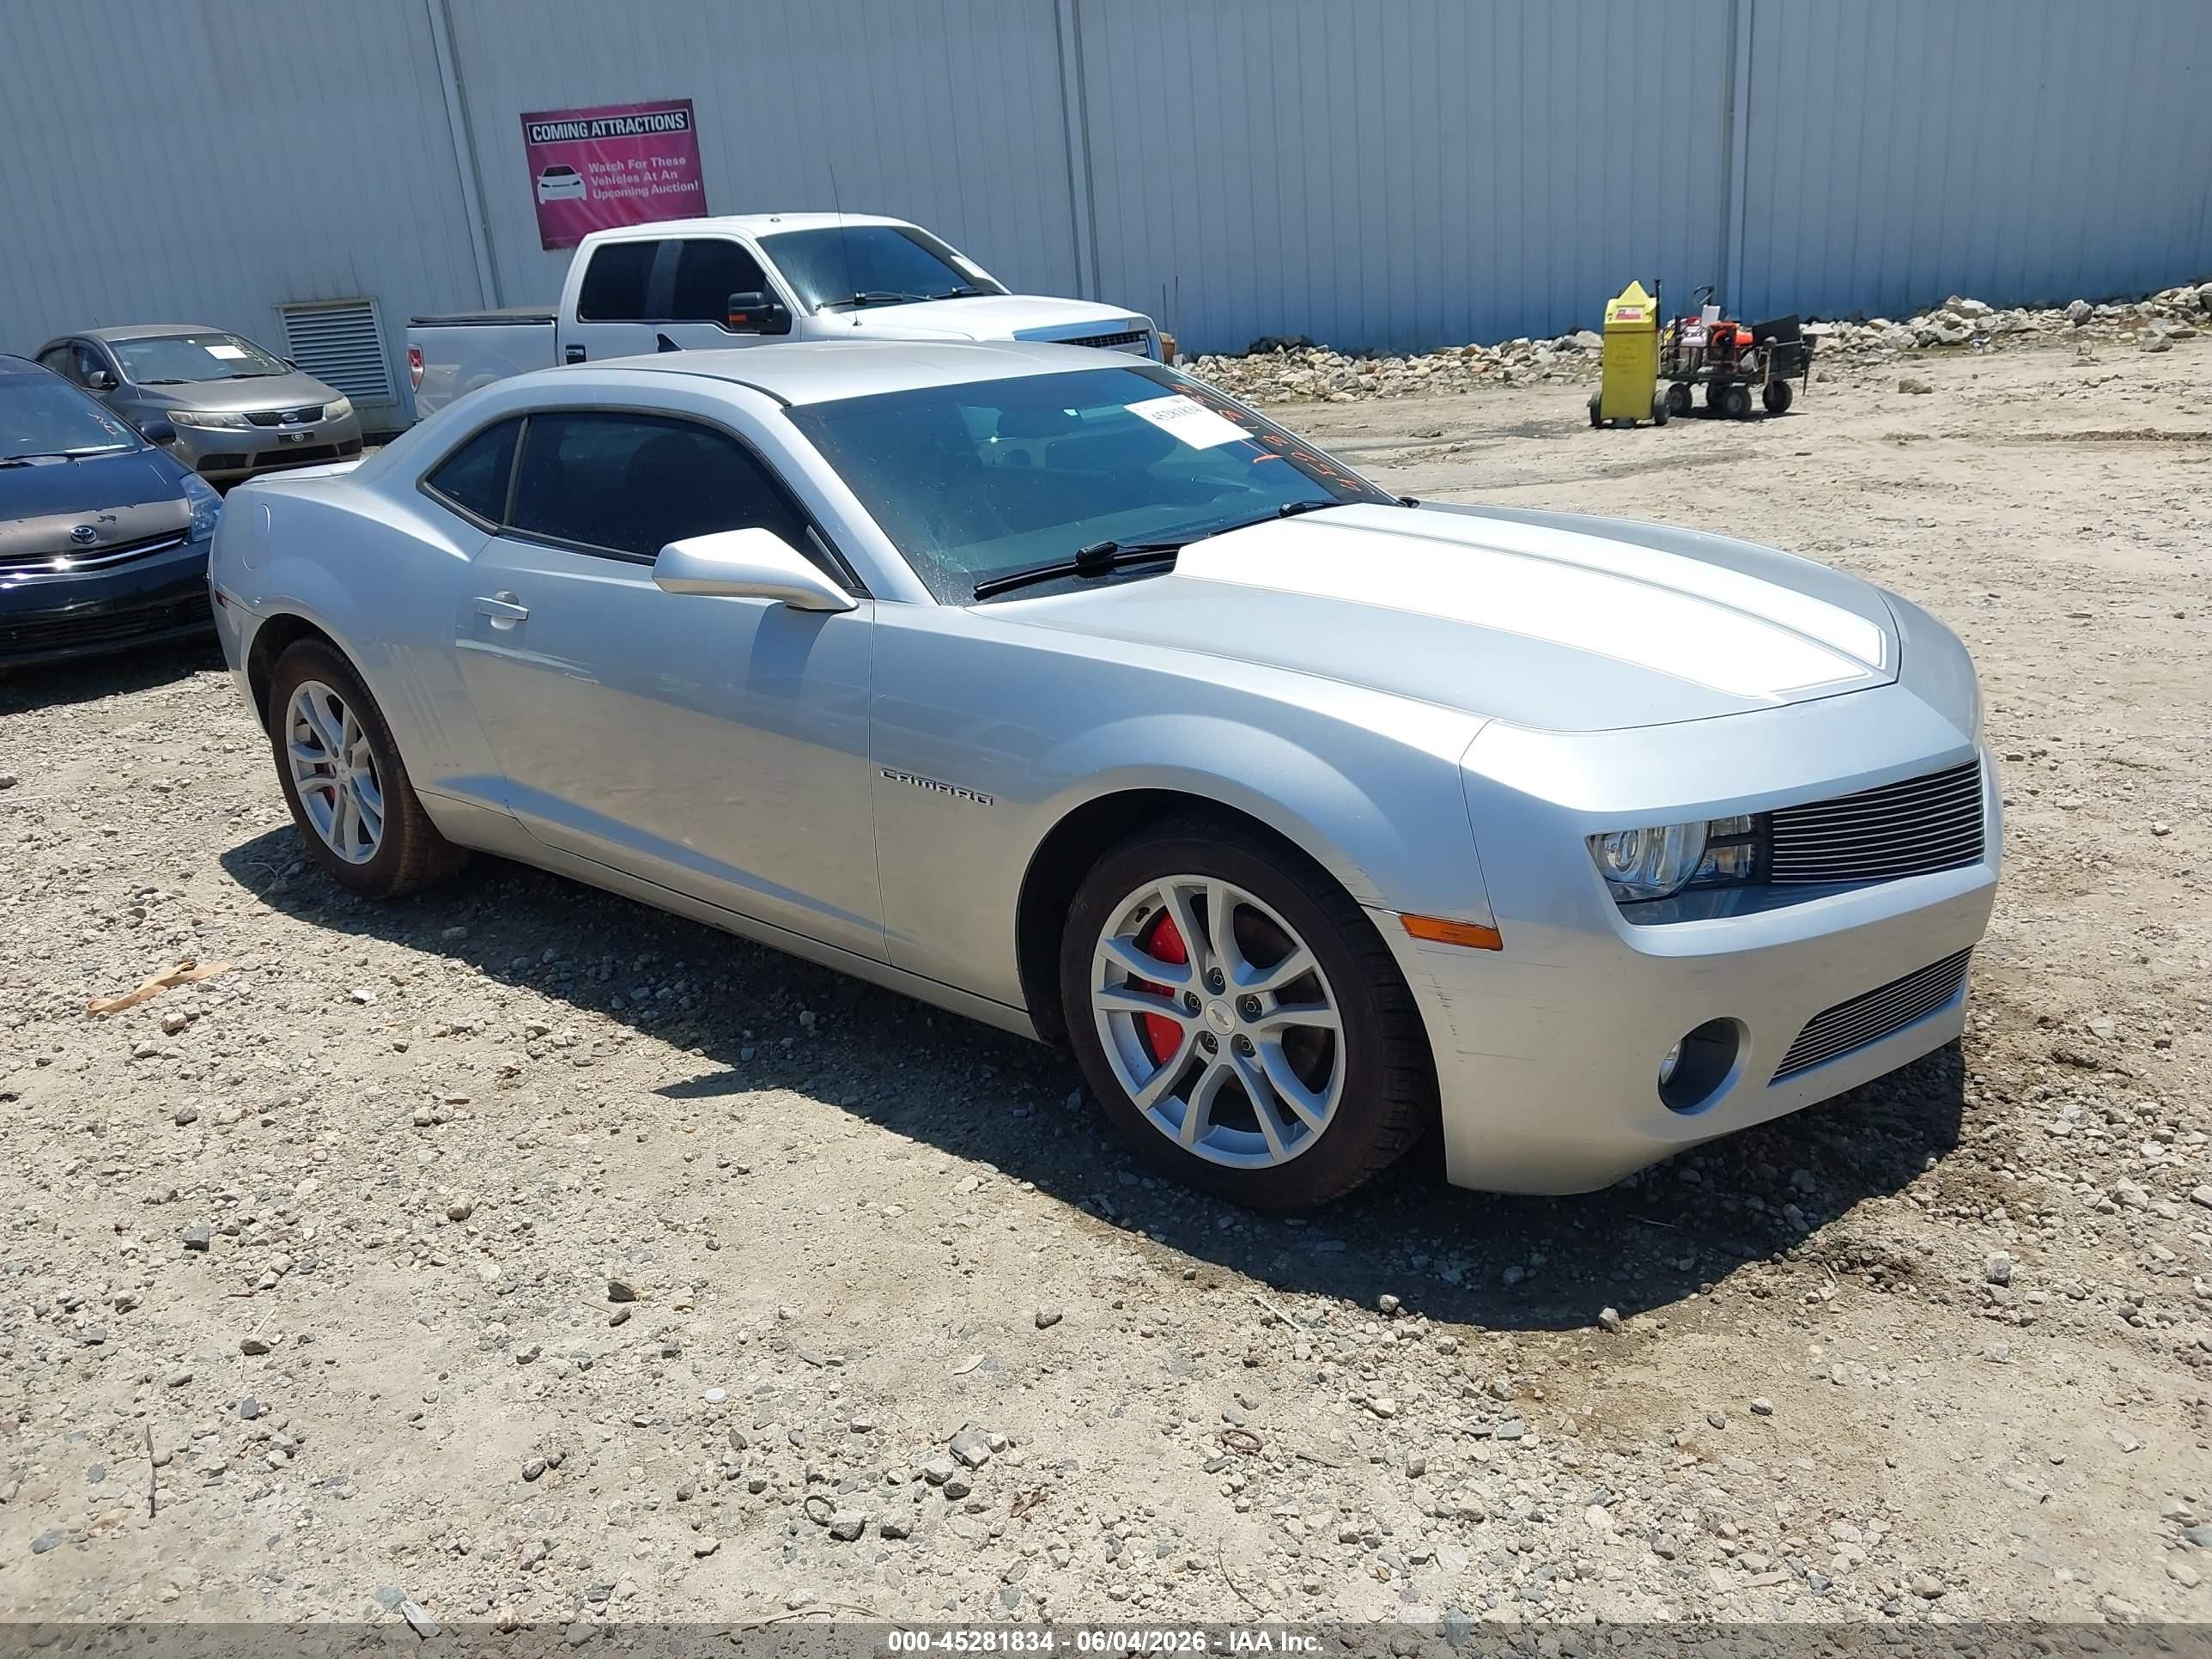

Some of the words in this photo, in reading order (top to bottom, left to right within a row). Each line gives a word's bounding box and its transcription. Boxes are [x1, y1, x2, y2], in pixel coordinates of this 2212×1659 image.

[532, 123, 588, 142] COMING
[591, 112, 685, 137] ATTRACTIONS
[588, 161, 624, 173] Watch
[628, 159, 647, 170] For
[650, 156, 686, 168] These
[591, 173, 640, 186] Vehicles
[643, 171, 657, 182] At
[661, 169, 678, 180] An
[592, 186, 649, 201] Upcoming
[651, 179, 699, 195] Auction!
[880, 768, 994, 805] CAMARO
